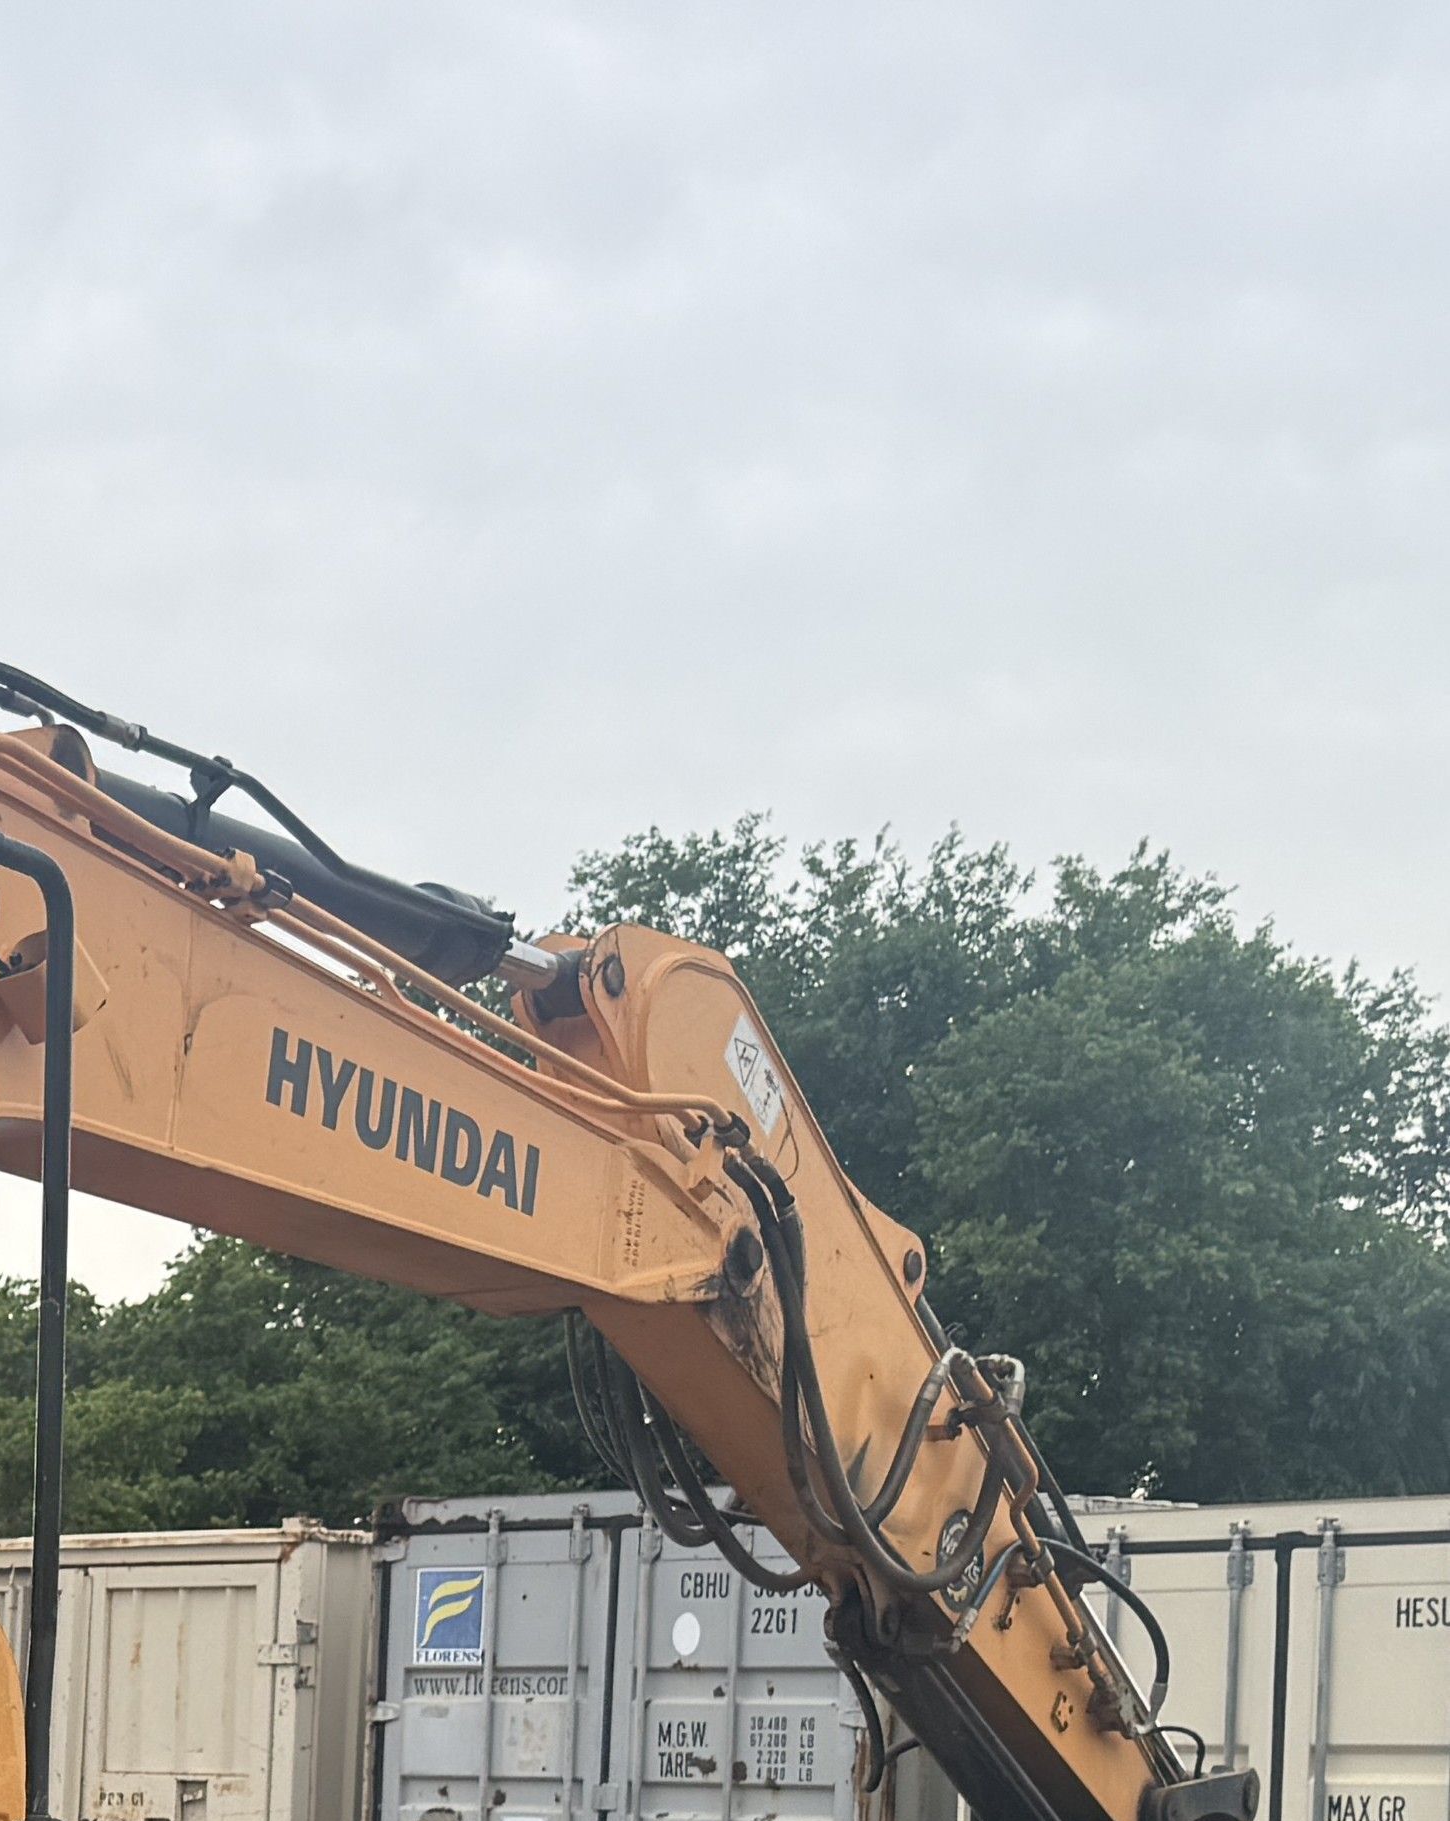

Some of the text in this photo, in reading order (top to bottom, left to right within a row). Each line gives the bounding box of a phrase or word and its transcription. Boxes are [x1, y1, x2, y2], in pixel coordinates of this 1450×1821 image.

[265, 1026, 540, 1217] HYUNDAI
[680, 1572, 730, 1599] CBHU
[751, 1607, 798, 1634] 22G1
[416, 1650, 481, 1663] FLORENS
[800, 1716, 815, 1731] KG
[658, 1721, 708, 1748] M.G.W.
[800, 1734, 814, 1749] LB
[658, 1751, 694, 1778] TARE
[799, 1751, 813, 1766] KG
[798, 1768, 812, 1782] LB
